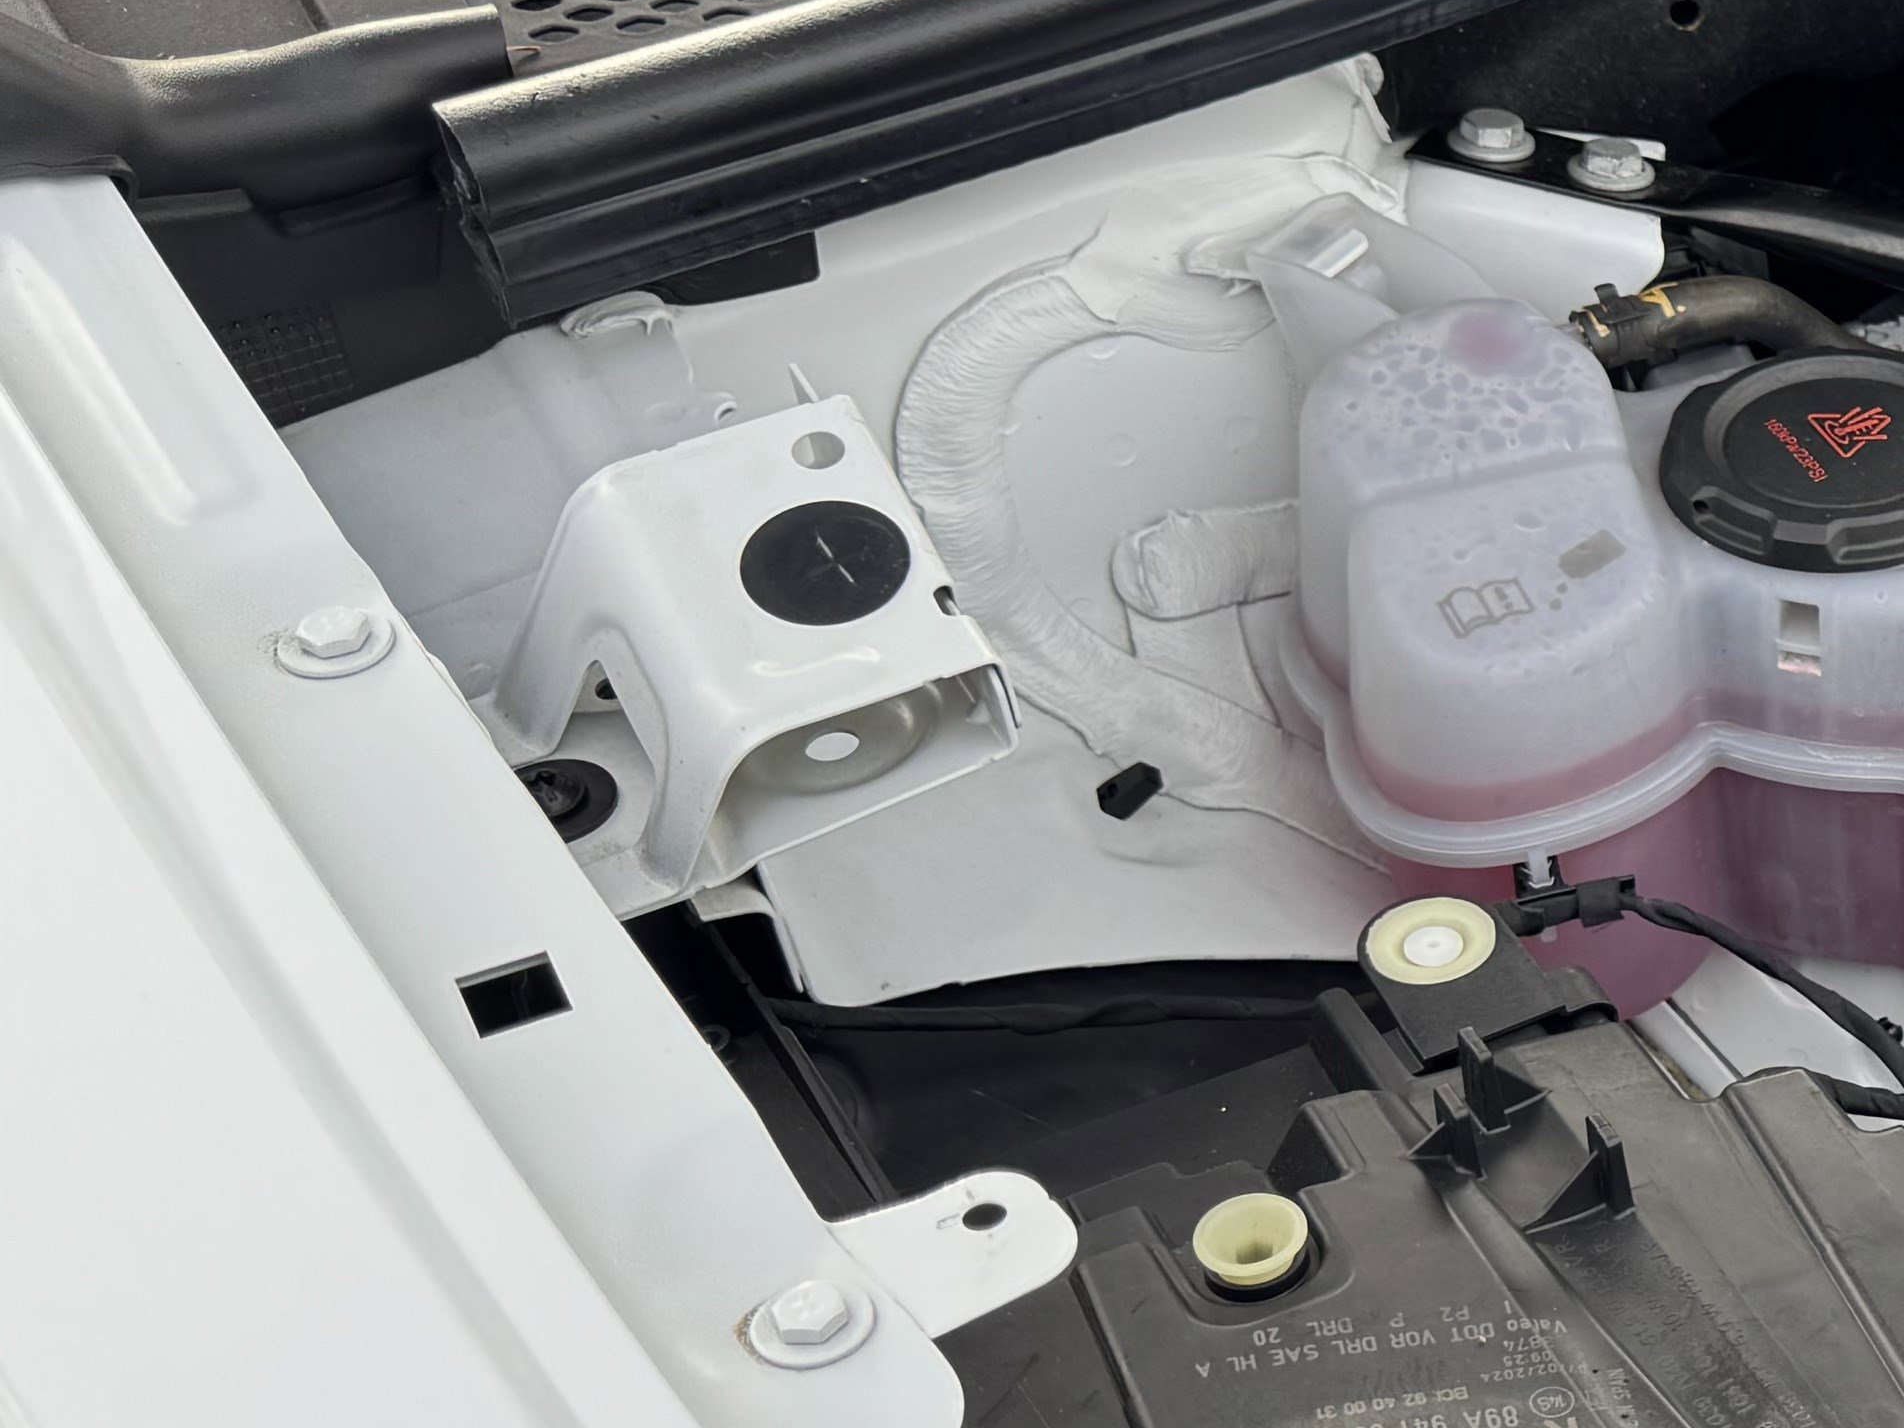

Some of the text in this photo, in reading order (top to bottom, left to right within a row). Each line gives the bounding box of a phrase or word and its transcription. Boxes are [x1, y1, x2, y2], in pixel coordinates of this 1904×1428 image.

[1251, 1325, 1281, 1345] 20
[1306, 1315, 1353, 1338] DRL
[1193, 1311, 1566, 1379] Valeo DOT VOR DRL SAE HL A
